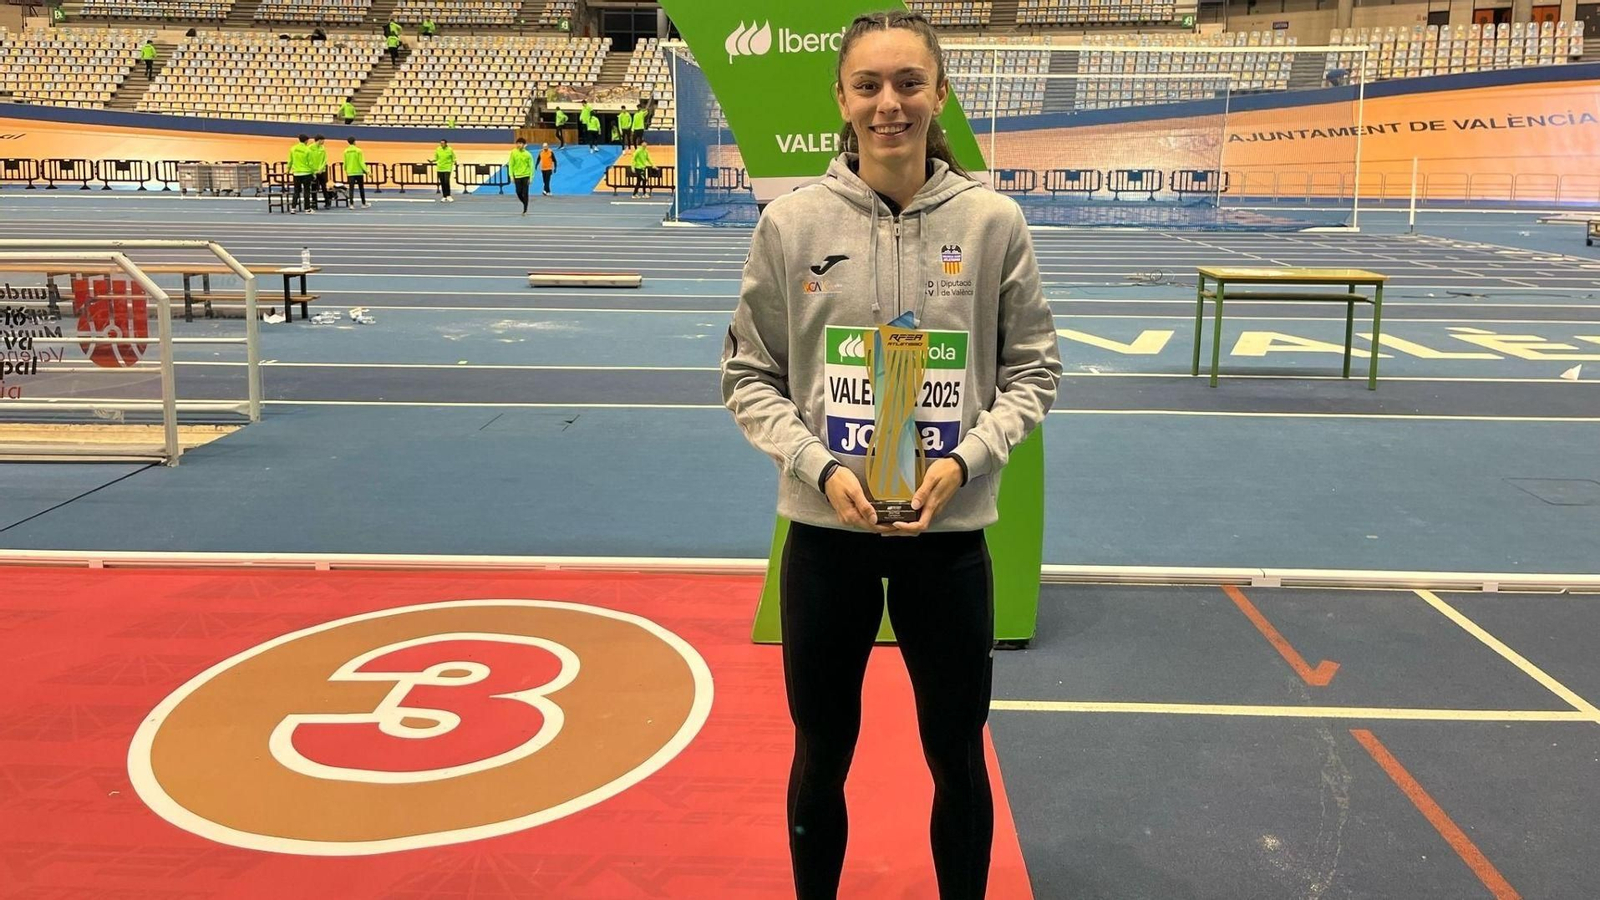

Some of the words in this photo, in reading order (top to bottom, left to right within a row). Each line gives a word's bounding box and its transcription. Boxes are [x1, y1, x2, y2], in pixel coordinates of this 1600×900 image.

[779, 27, 847, 53] Iberd
[1228, 122, 1402, 144] AJUNTAMENT
[1410, 119, 1446, 131] DE
[927, 342, 956, 361] ola
[1055, 327, 1600, 361] VALÈ
[922, 381, 960, 408] 2025
[841, 422, 944, 452] Joa
[269, 632, 580, 784] 3
